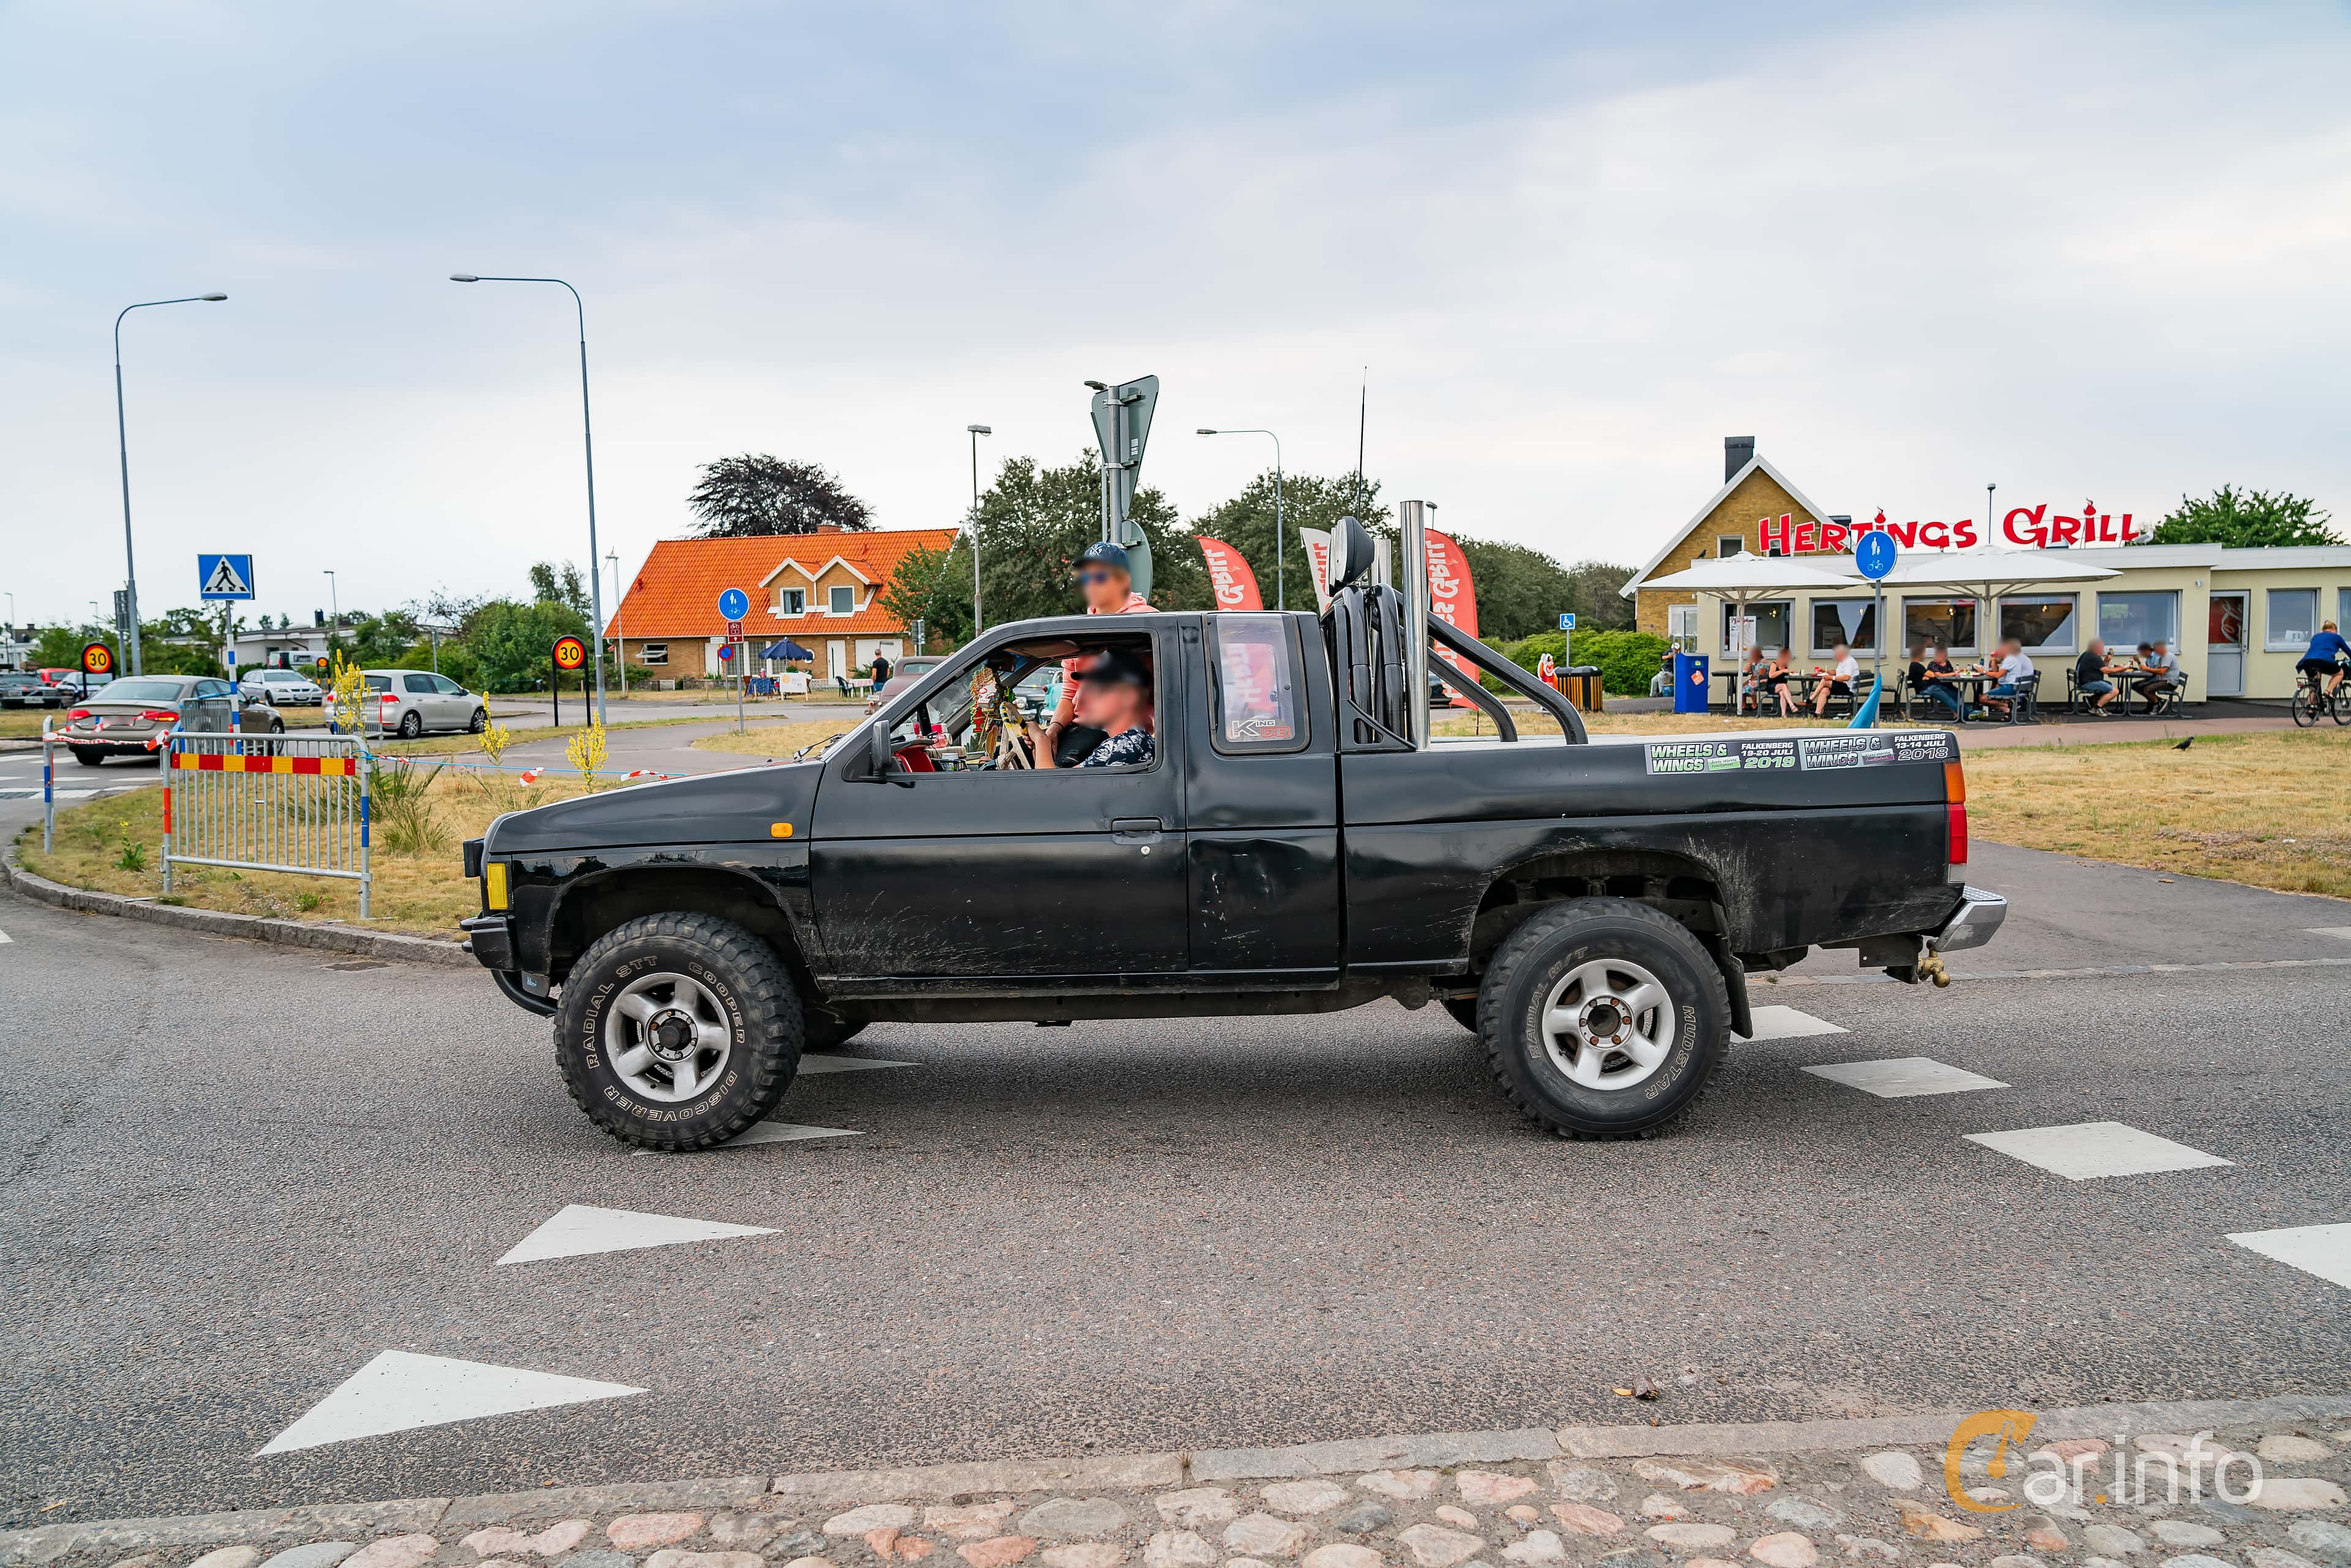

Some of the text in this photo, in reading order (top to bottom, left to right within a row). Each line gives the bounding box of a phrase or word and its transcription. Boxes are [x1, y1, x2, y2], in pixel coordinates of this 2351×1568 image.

[89, 653, 107, 666] 30
[560, 647, 579, 660] 30
[1805, 737, 1881, 753] WHEELS &
[1895, 733, 1946, 742] FALKENBERG
[1651, 743, 1728, 758] WHEELS &
[1741, 742, 1794, 751] FALKENBERG
[1898, 747, 1948, 761] 2018
[1652, 758, 1704, 773] WINGS
[1744, 756, 1795, 769] 2019
[1807, 752, 1858, 768] WINGS
[688, 962, 745, 1044] COOPER
[583, 955, 658, 1069] RADIAL STT
[1525, 982, 1548, 1059] RADIAL
[1644, 1005, 1696, 1100] MUDSTAR
[604, 1070, 738, 1122] DISCOVERER
